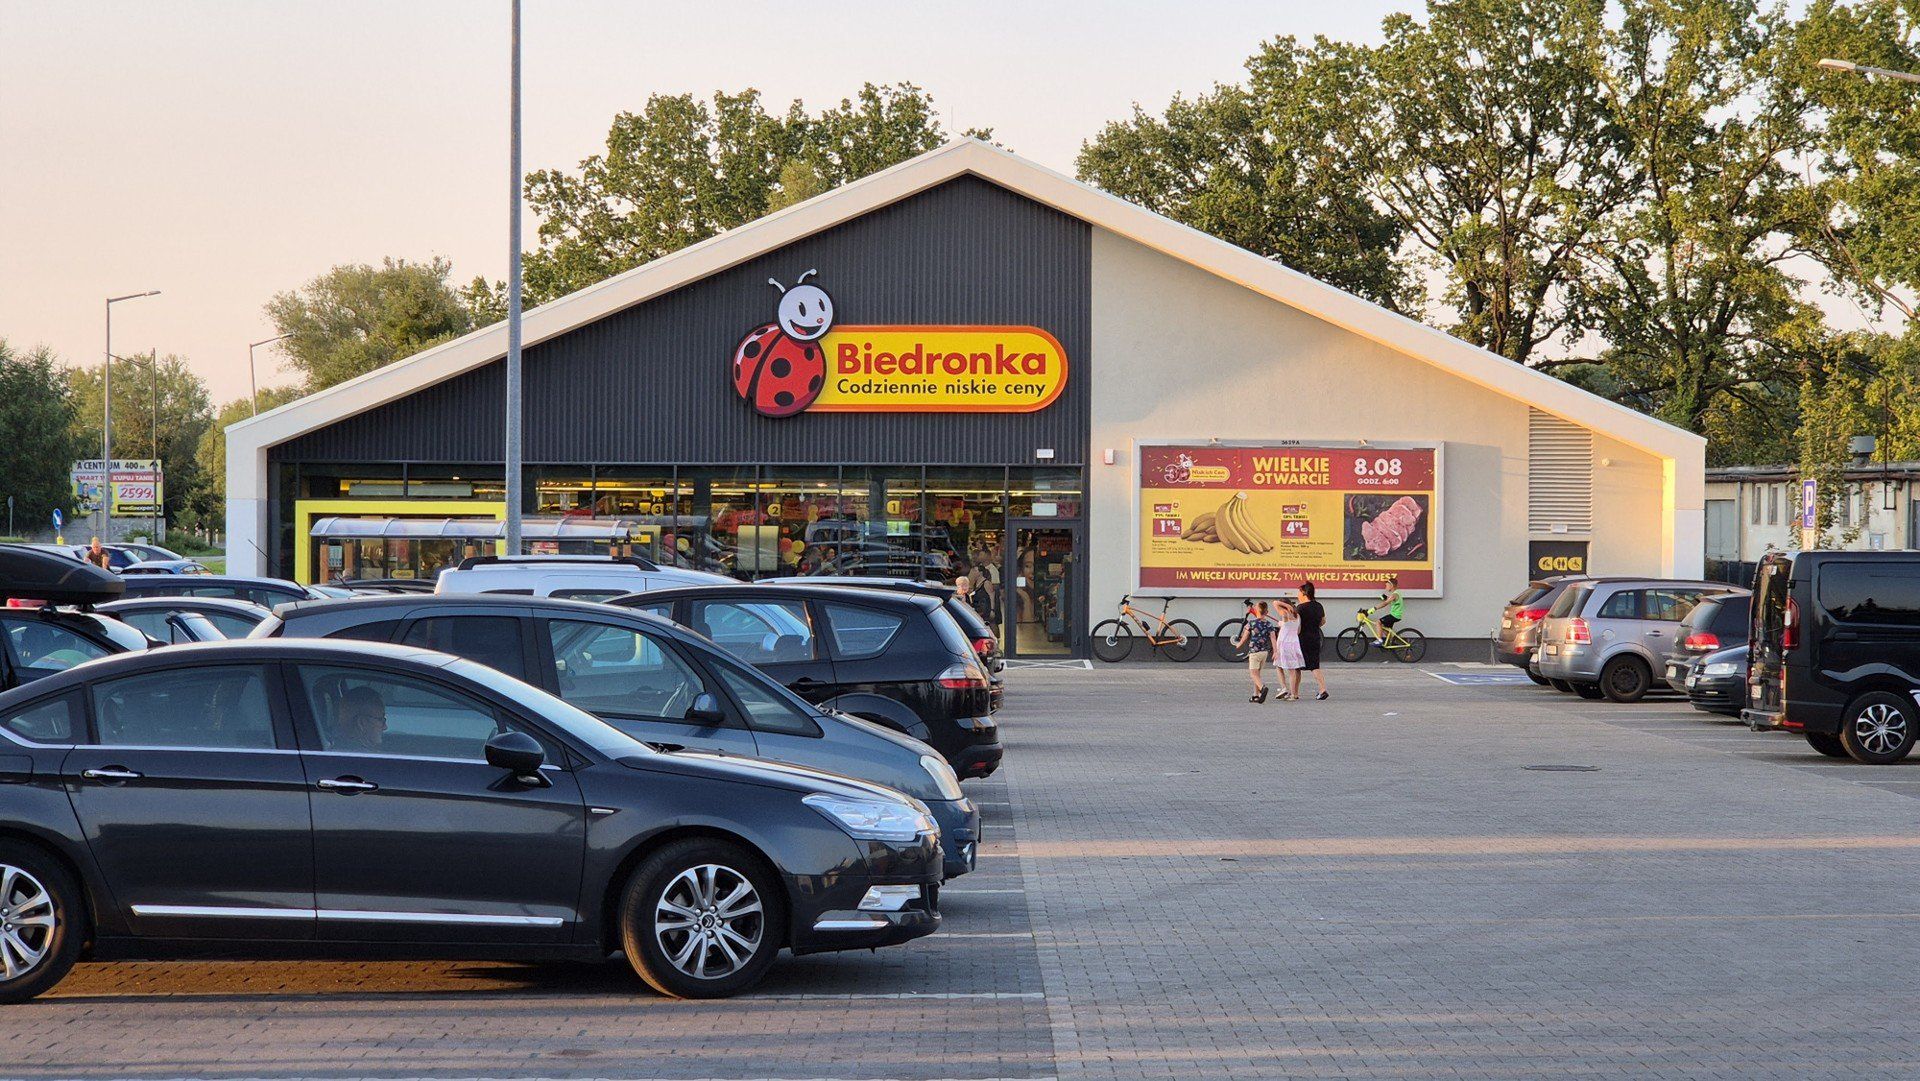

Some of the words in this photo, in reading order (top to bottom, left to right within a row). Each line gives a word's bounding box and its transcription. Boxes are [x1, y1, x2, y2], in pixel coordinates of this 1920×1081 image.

[837, 342, 1047, 375] Biedronka
[837, 378, 938, 394] Codziennie
[945, 379, 997, 394] niskie
[1004, 383, 1046, 397] ceny
[83, 461, 120, 470] CENTUM
[1252, 456, 1330, 473] WIELKIE
[1354, 458, 1402, 476] 8.08
[1252, 473, 1330, 485] OTWARCIE
[1805, 485, 1813, 515] P
[655, 505, 662, 514] 3
[772, 505, 779, 514] 2
[1176, 570, 1188, 580] IM
[1190, 571, 1226, 581] WIĘCEJ
[1228, 571, 1282, 582] KUPUJESZ,
[1284, 571, 1303, 581] TYM
[1305, 572, 1340, 582] WIĘCEJ
